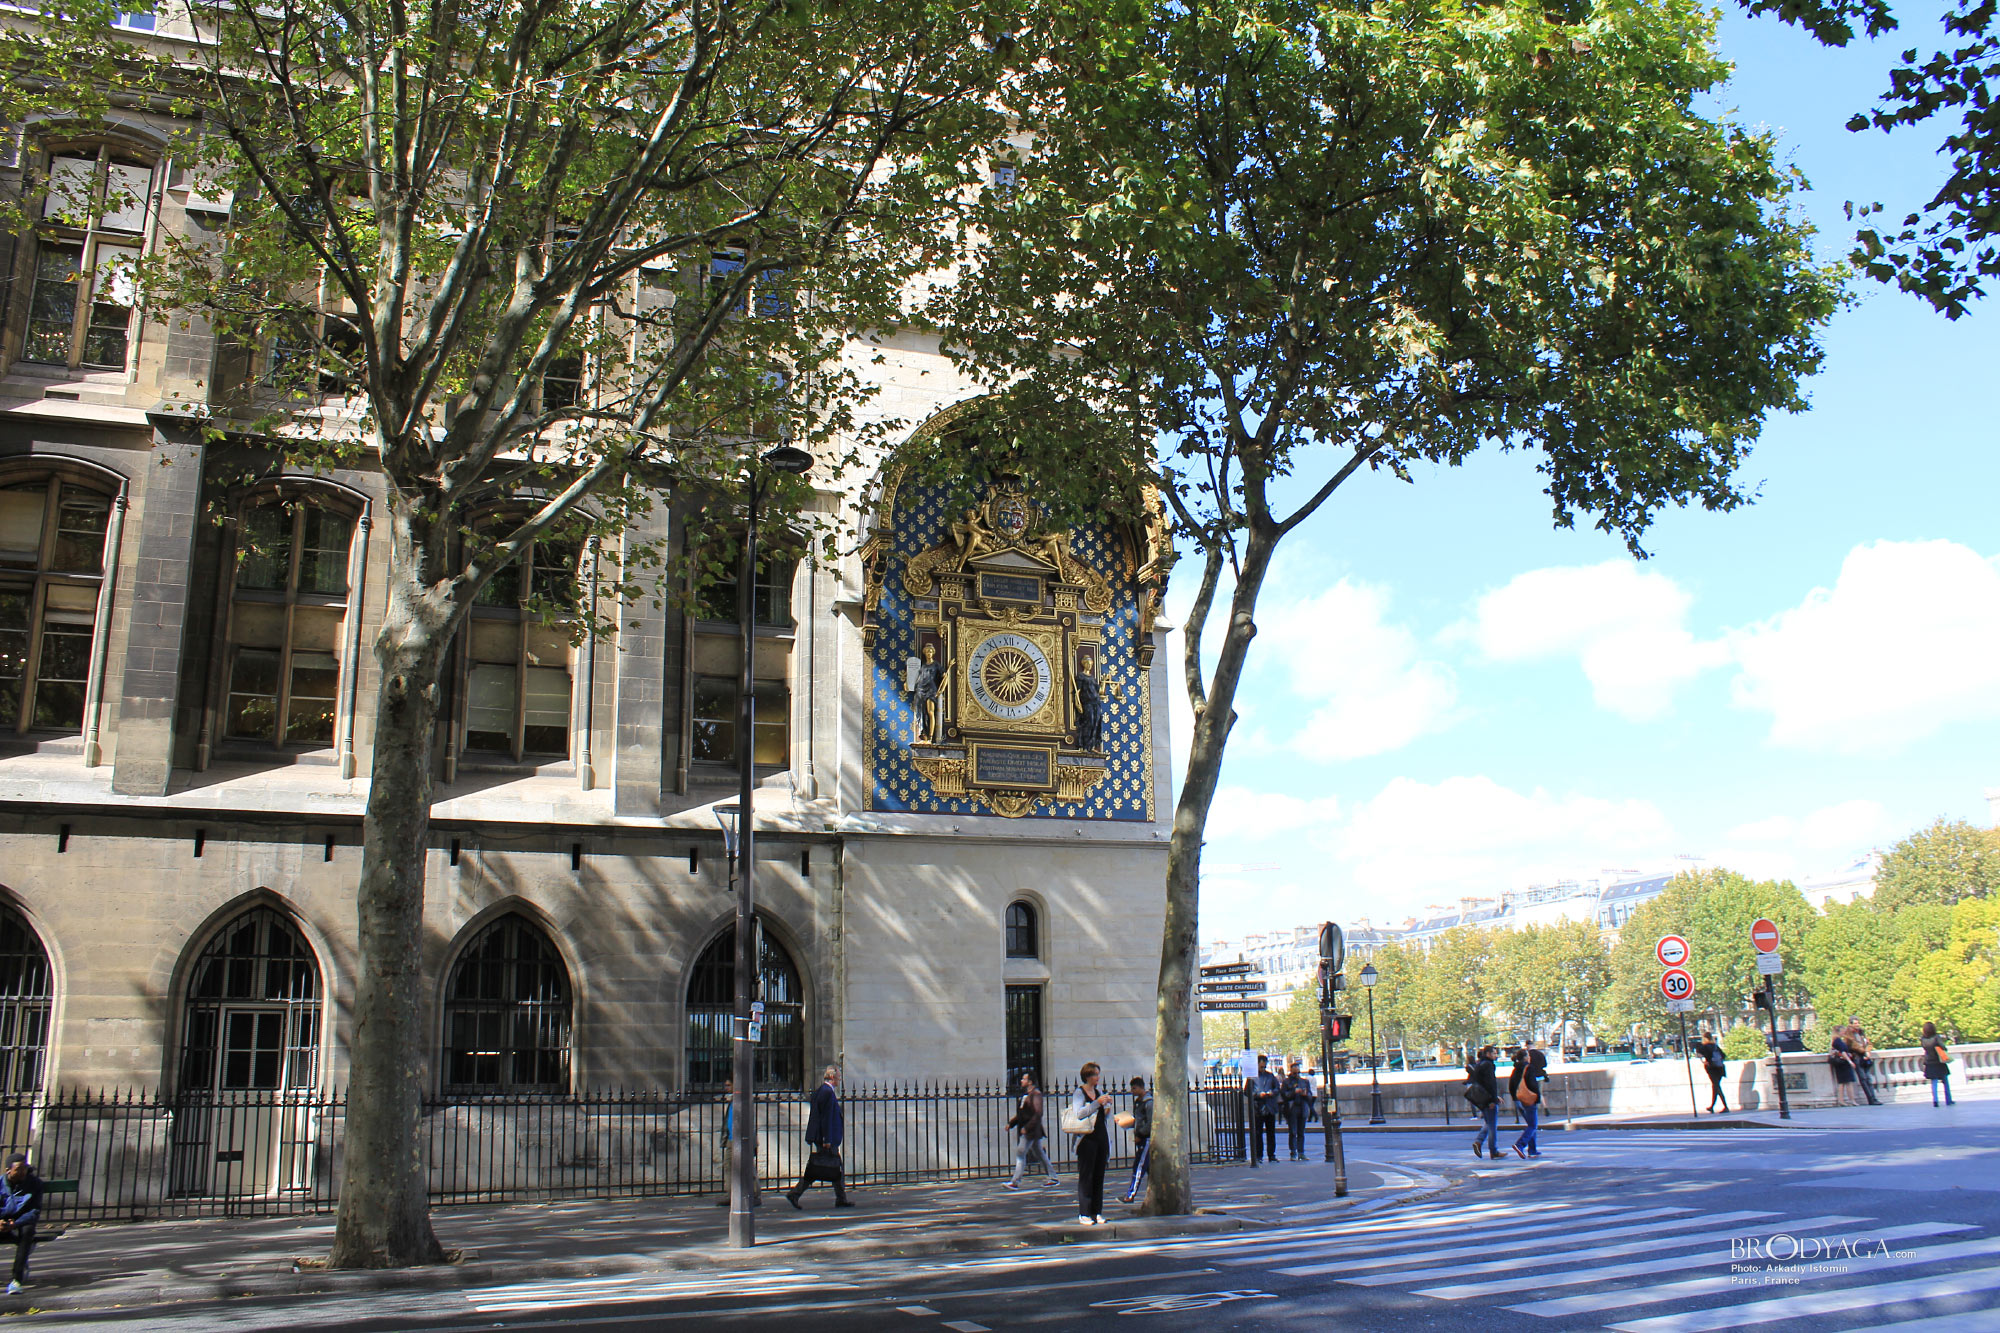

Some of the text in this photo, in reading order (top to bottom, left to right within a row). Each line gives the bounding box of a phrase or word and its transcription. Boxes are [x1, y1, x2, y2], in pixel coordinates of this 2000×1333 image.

[1003, 637, 1014, 646] XII
[1234, 983, 1257, 991] CHAPELLE
[1667, 977, 1687, 992] 30
